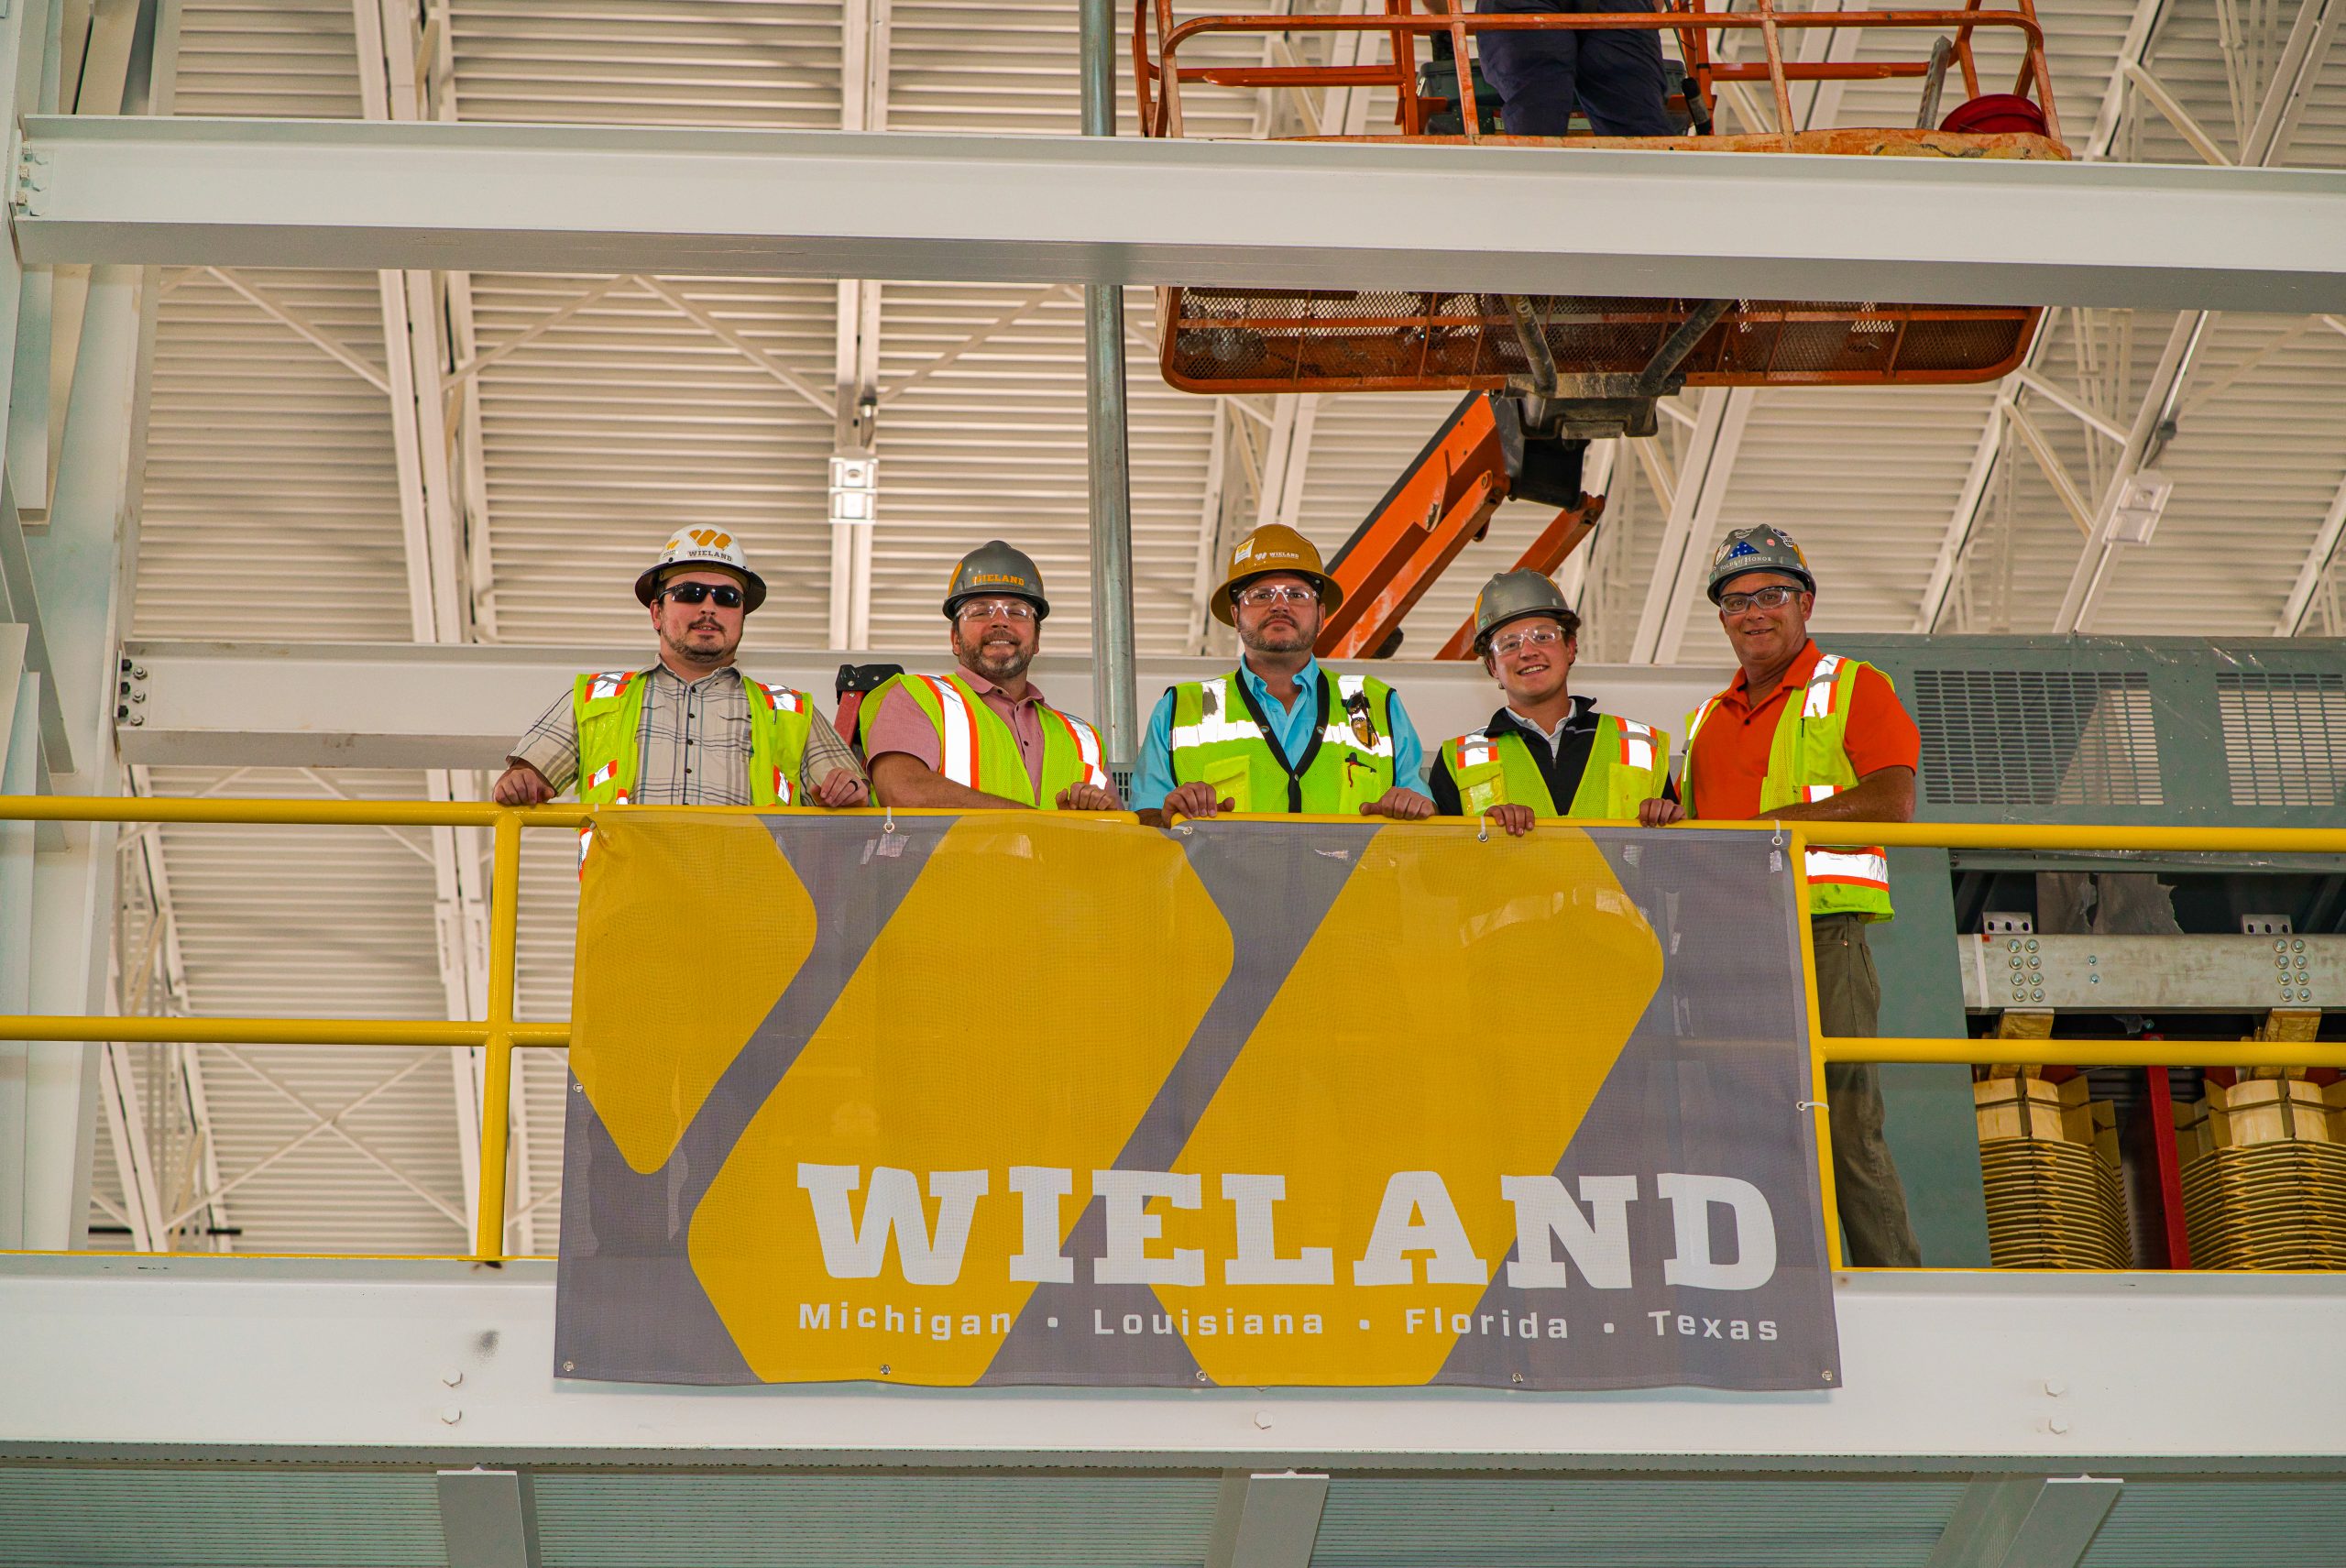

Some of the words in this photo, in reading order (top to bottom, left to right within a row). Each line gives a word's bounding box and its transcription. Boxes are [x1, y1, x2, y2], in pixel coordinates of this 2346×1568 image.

[688, 550, 732, 562] WIELAND
[972, 574, 1025, 587] WIELAND
[796, 1162, 1778, 1290] WIELAND
[798, 1301, 1011, 1341] Michigan
[1093, 1308, 1323, 1336] Louisiana
[1405, 1308, 1569, 1339] Florida
[1648, 1310, 1779, 1341] Texas
